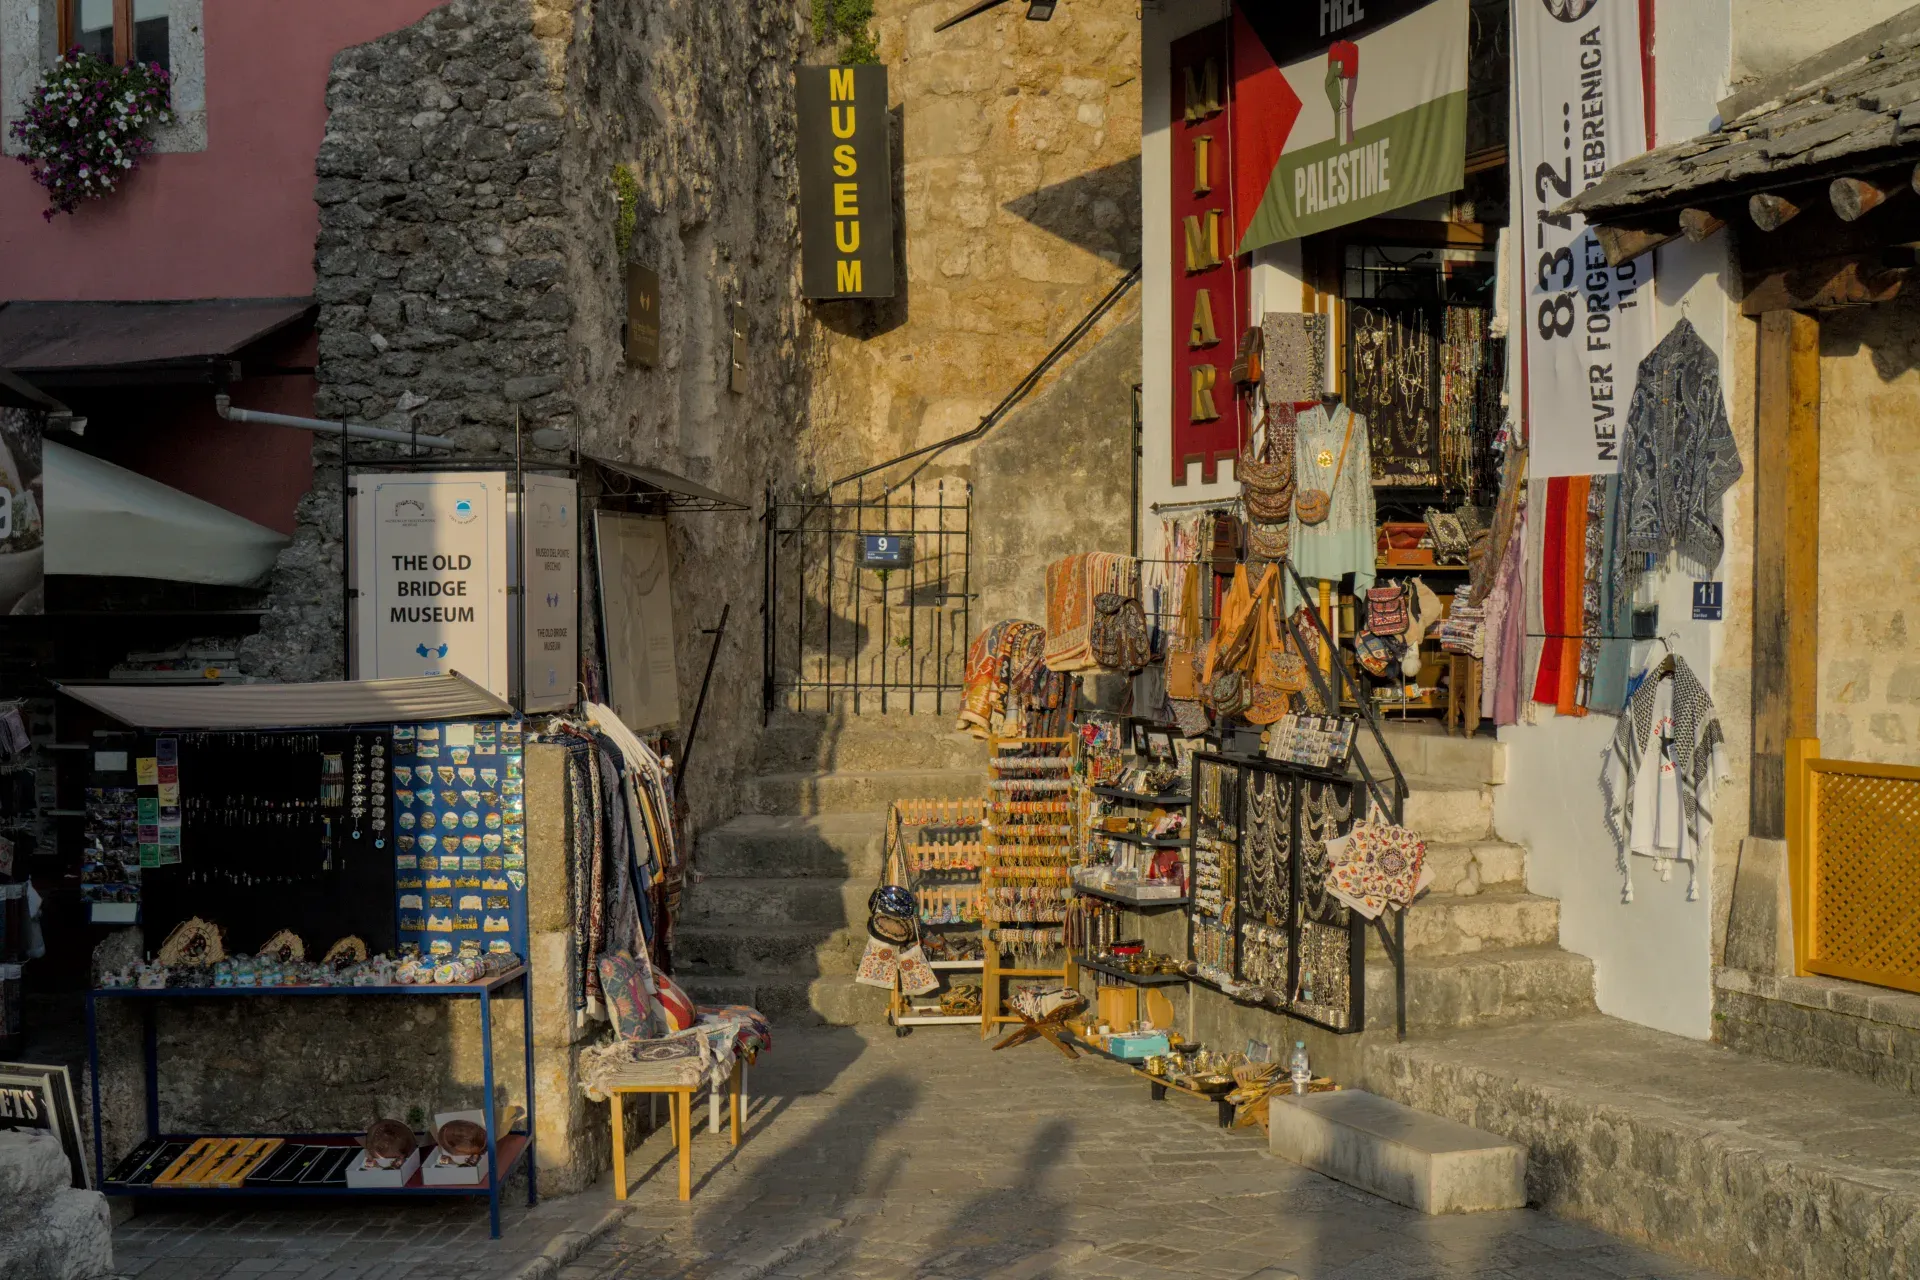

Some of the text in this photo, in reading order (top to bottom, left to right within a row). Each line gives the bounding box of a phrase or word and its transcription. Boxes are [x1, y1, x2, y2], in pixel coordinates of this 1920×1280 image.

[829, 68, 863, 292] MUSEUM
[1294, 138, 1390, 217] PALESTINE
[1182, 56, 1225, 423] MIMAR
[1580, 24, 1618, 461] NEVER FORGET EBRENICA
[1616, 261, 1637, 313] 11.0
[878, 537, 888, 551] 9
[392, 554, 471, 571] THE OLD
[397, 580, 467, 597] BRIDGE
[1699, 584, 1715, 604] 11
[390, 606, 475, 623] MUSEUM
[537, 628, 545, 638] THE
[545, 628, 553, 638] OLD
[543, 641, 561, 651] MUSEUM
[1659, 761, 1678, 773] TAR
